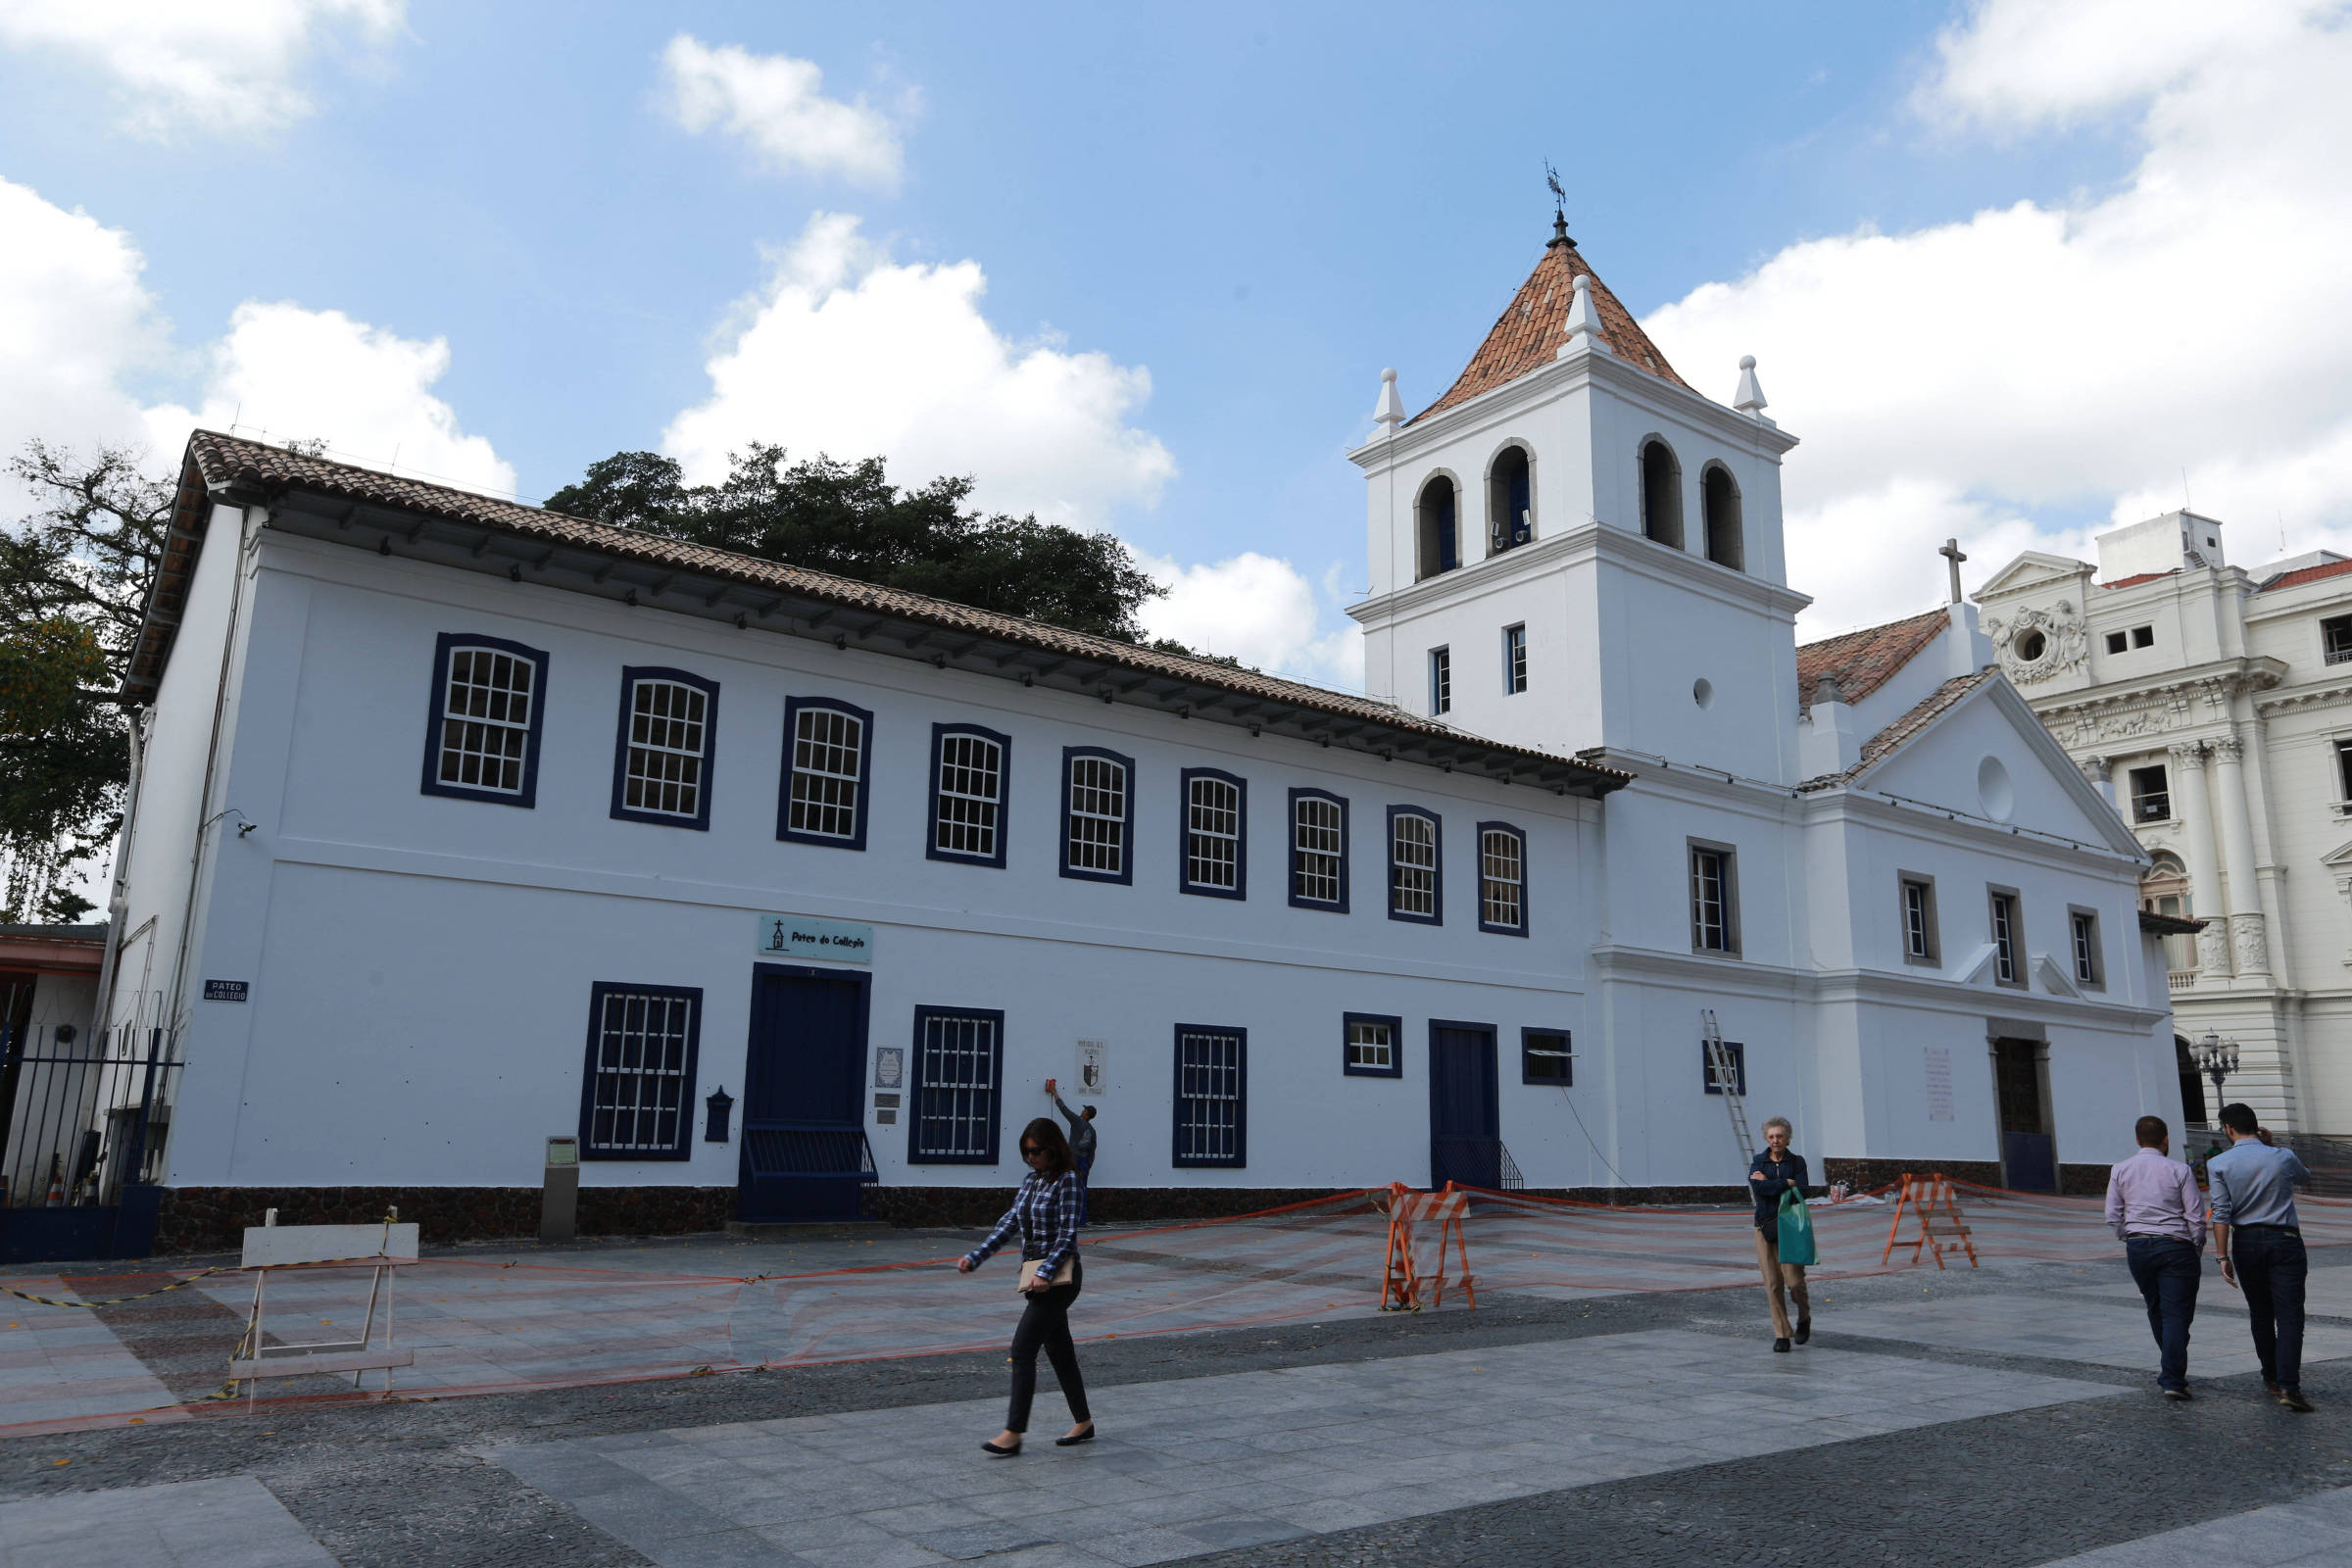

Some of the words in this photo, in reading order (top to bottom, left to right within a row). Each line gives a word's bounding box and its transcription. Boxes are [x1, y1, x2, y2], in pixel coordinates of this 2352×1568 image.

[791, 931, 816, 943] Pateo
[819, 935, 830, 945] do
[832, 936, 865, 949] Collegio
[212, 982, 242, 991] PATEO
[214, 990, 246, 1001] COLLEGIO
